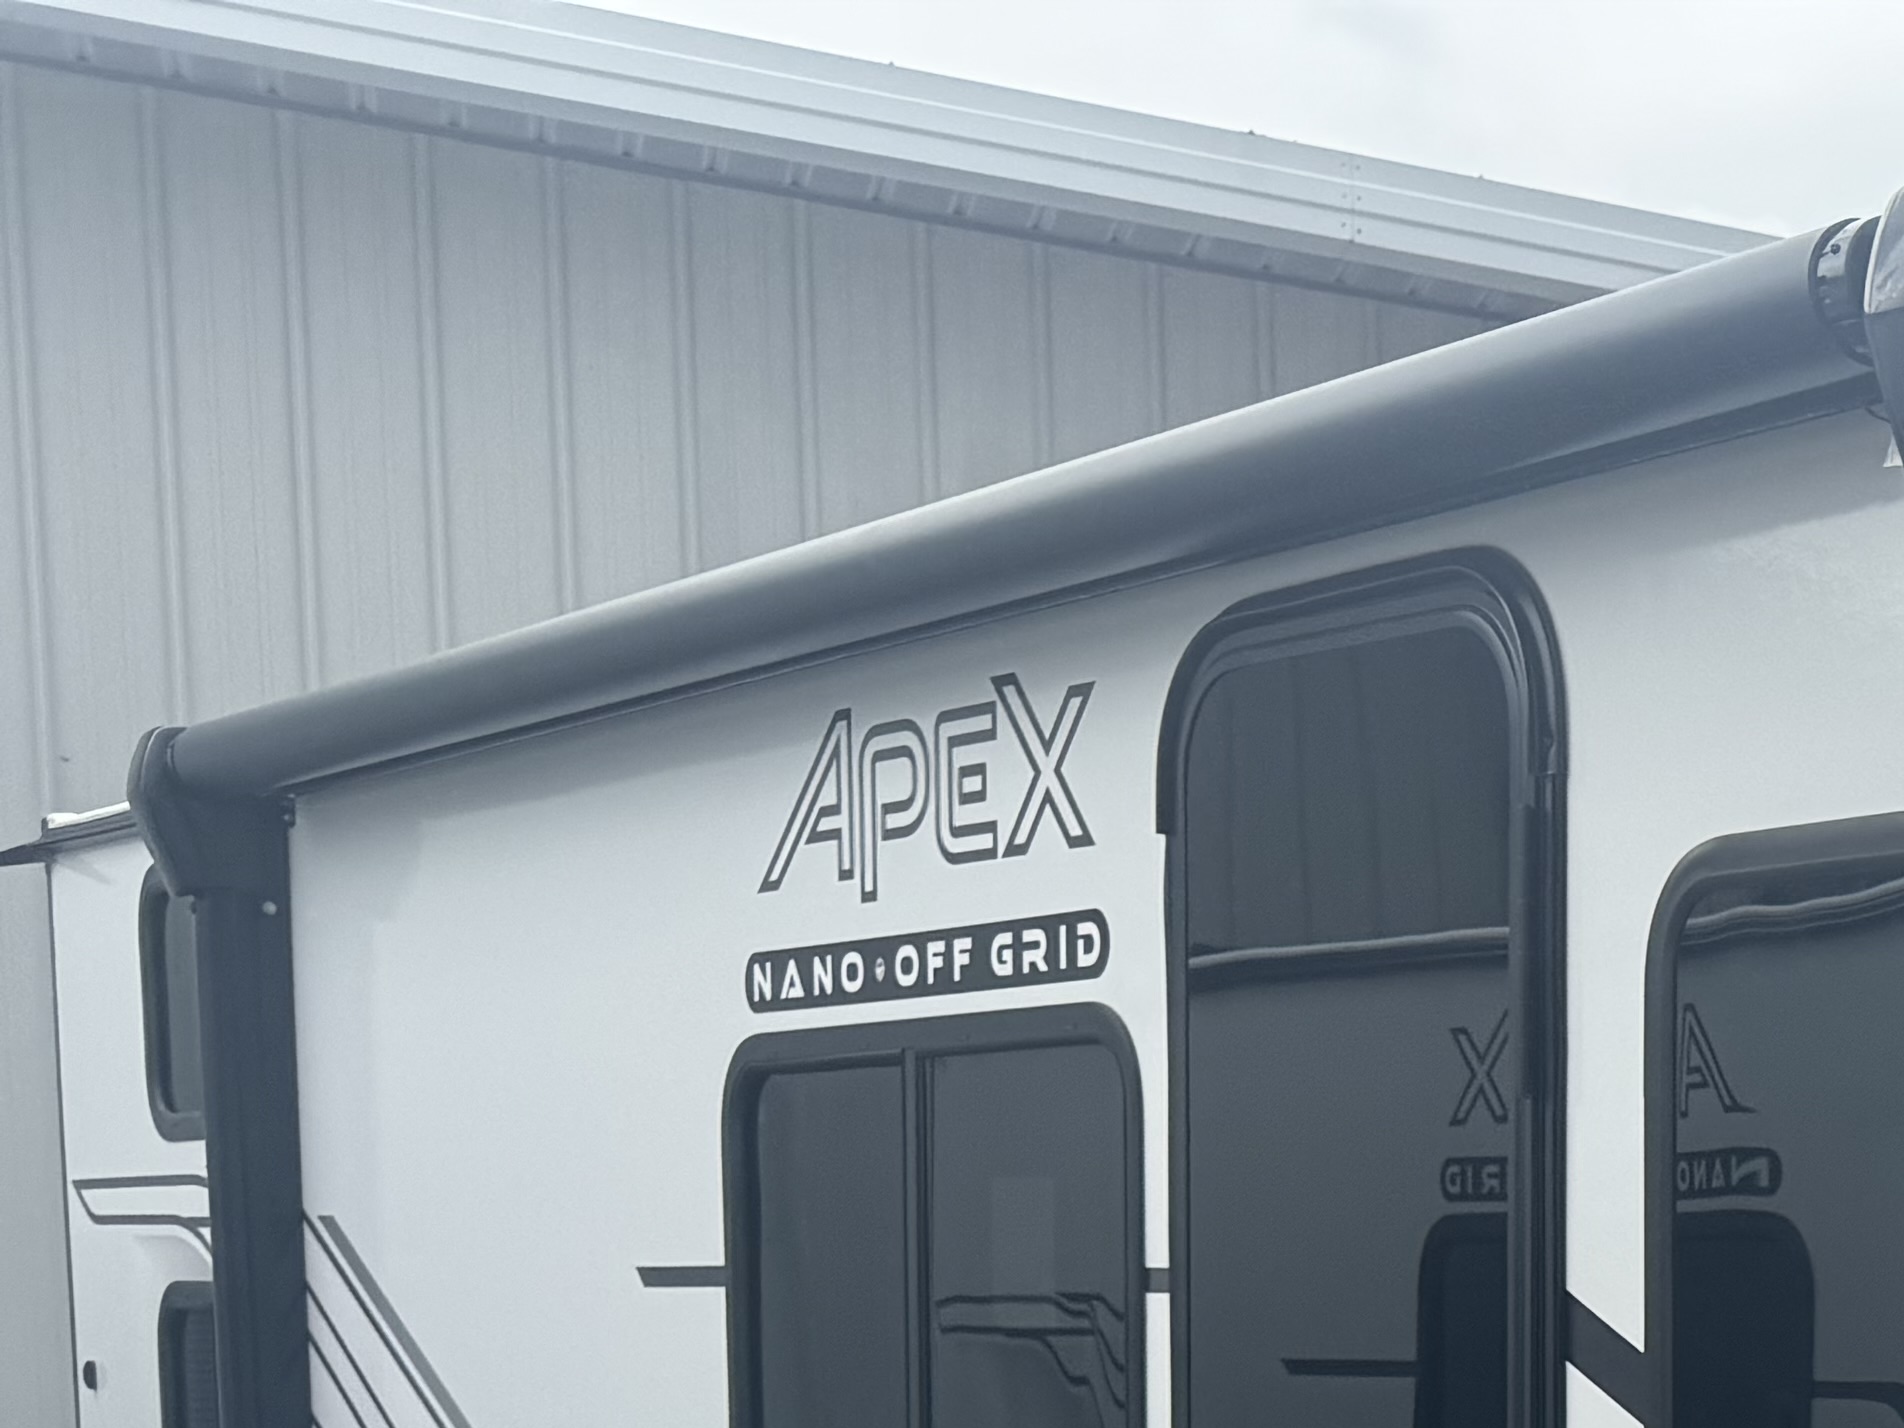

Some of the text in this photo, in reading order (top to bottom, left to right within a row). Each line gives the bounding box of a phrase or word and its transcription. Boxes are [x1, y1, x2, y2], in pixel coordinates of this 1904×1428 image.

[757, 672, 1096, 903] APEX
[752, 921, 1101, 1002] NANO OFF GRID
